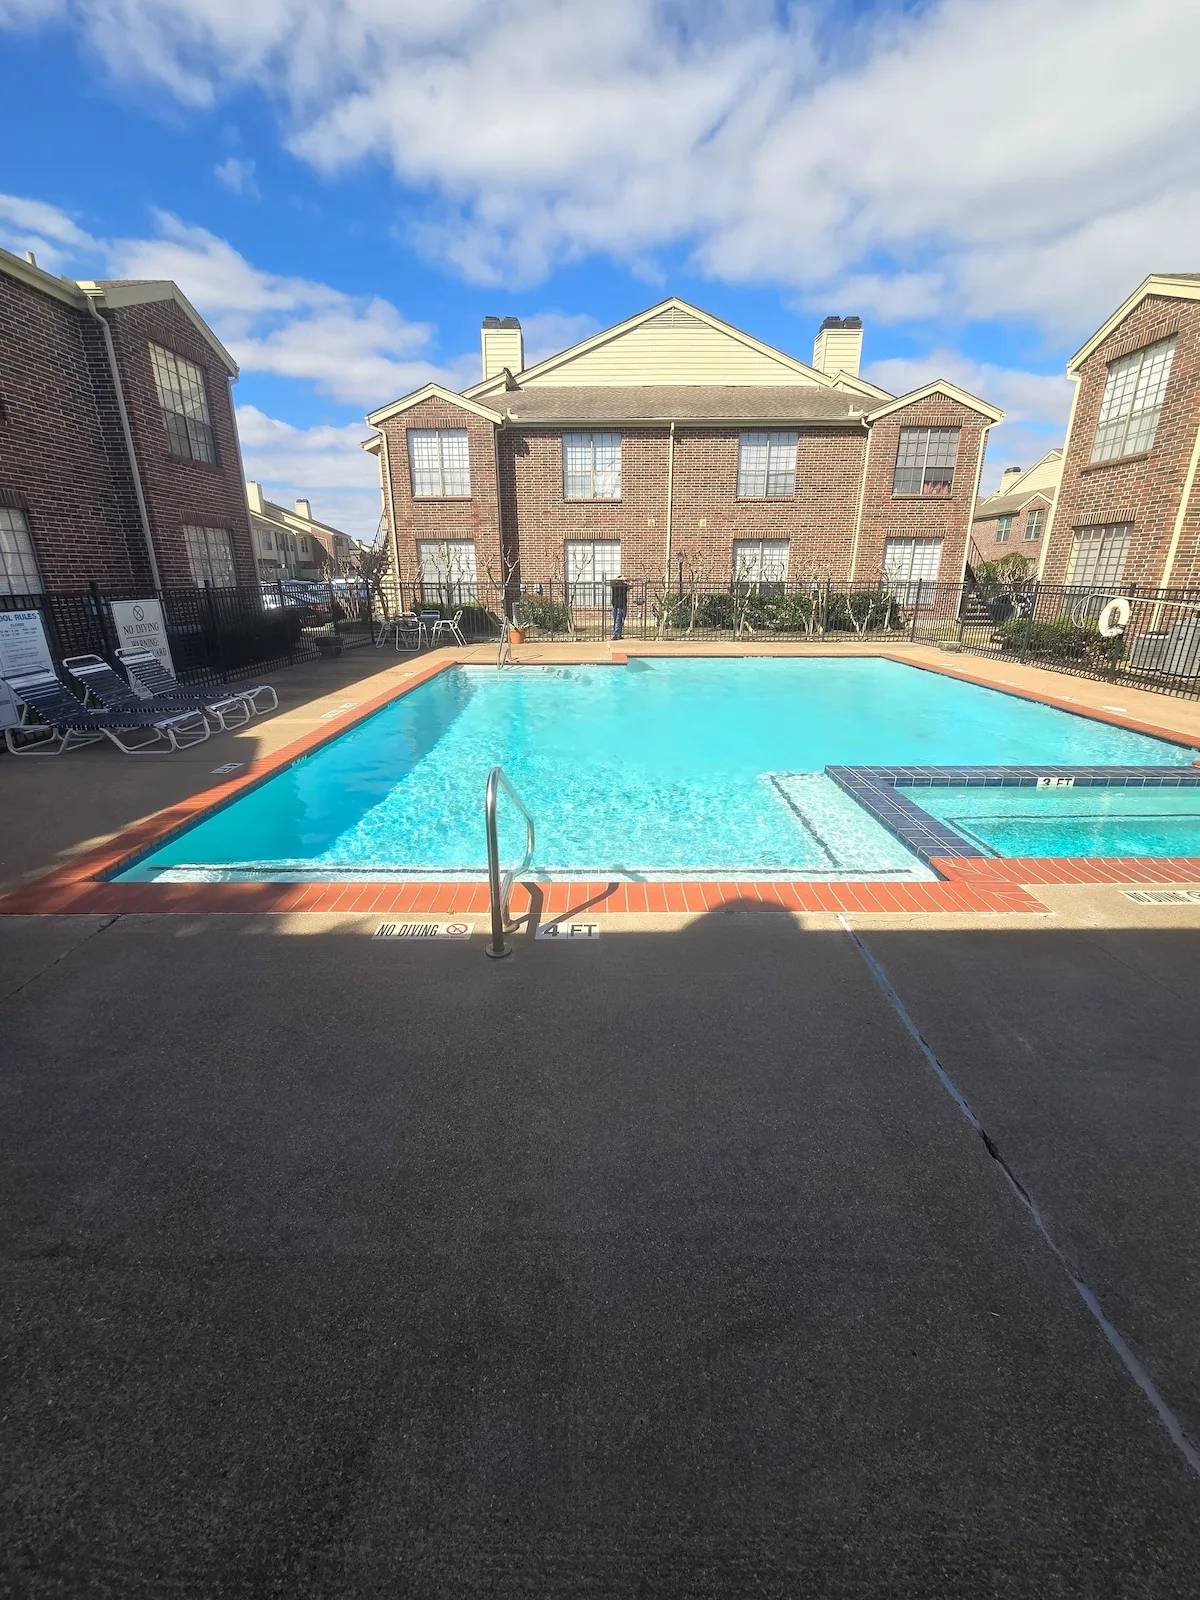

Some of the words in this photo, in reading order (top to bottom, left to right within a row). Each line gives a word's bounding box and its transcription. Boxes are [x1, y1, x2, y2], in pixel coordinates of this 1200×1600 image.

[14, 613, 37, 621] RULES
[122, 625, 134, 635] NO
[135, 622, 160, 634] DIVING
[1056, 778, 1073, 787] FT
[1125, 892, 1151, 903] NO
[1143, 892, 1192, 903] DIVING
[375, 924, 396, 937] NO
[397, 924, 439, 937] DIVING
[543, 924, 560, 937] 4
[570, 924, 597, 937] FT
